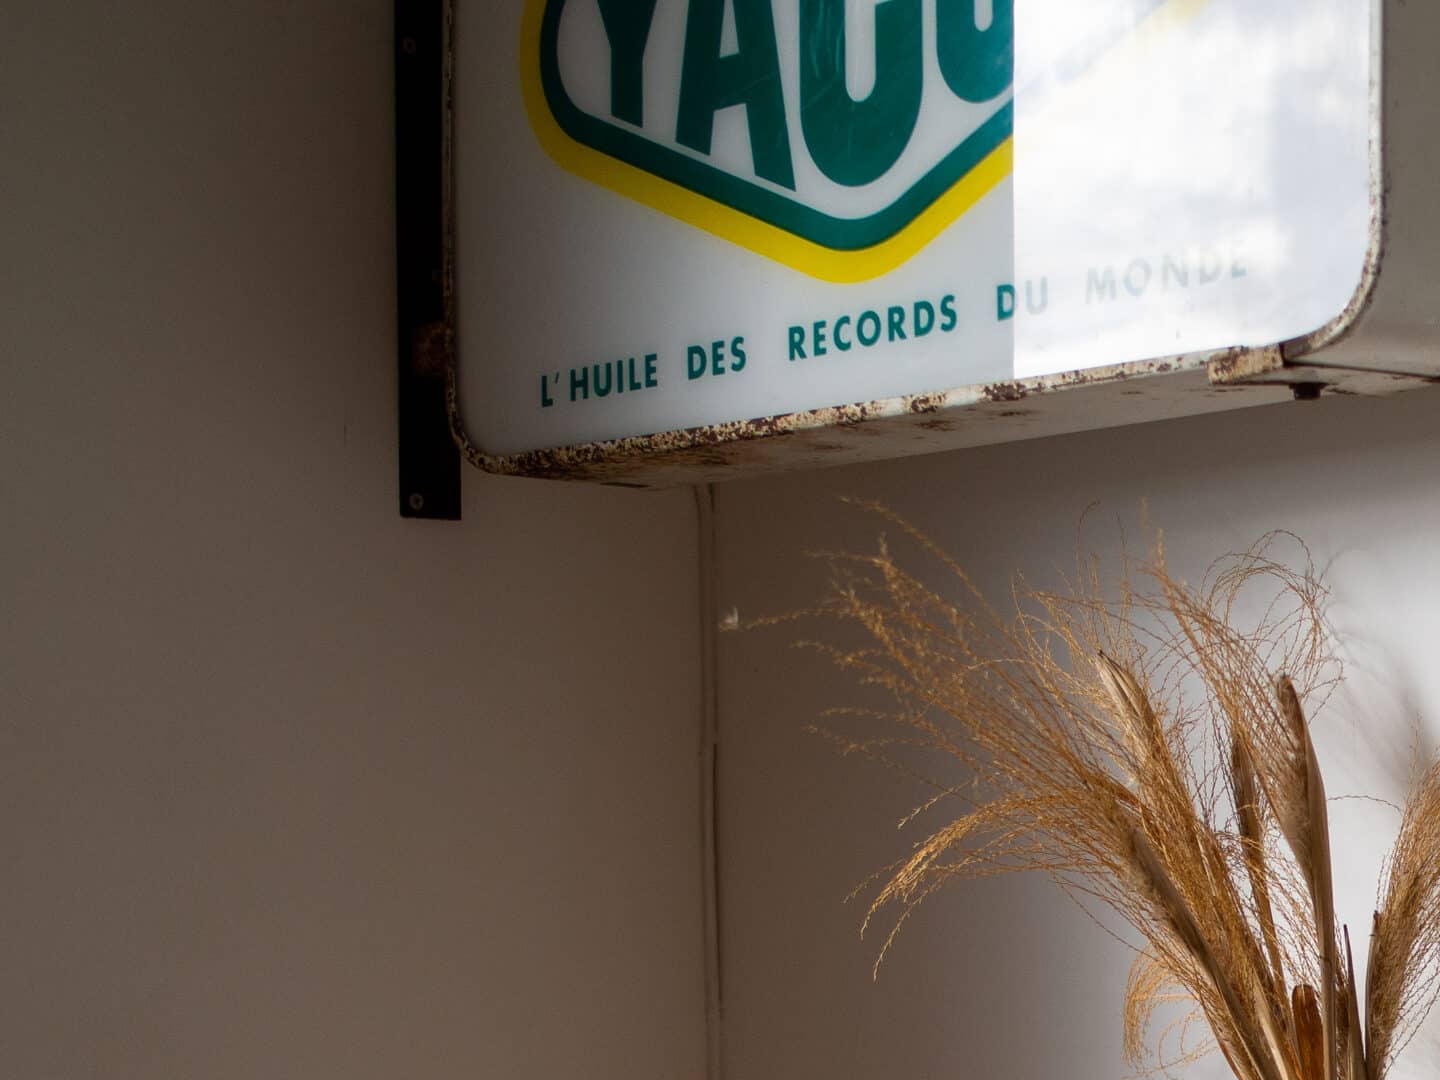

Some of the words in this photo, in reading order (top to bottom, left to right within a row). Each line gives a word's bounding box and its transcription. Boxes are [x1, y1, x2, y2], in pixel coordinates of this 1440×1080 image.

[541, 353, 659, 408] L'HUILE
[687, 336, 747, 381] DES
[788, 294, 958, 361] RECORDS
[995, 276, 1049, 322] DU
